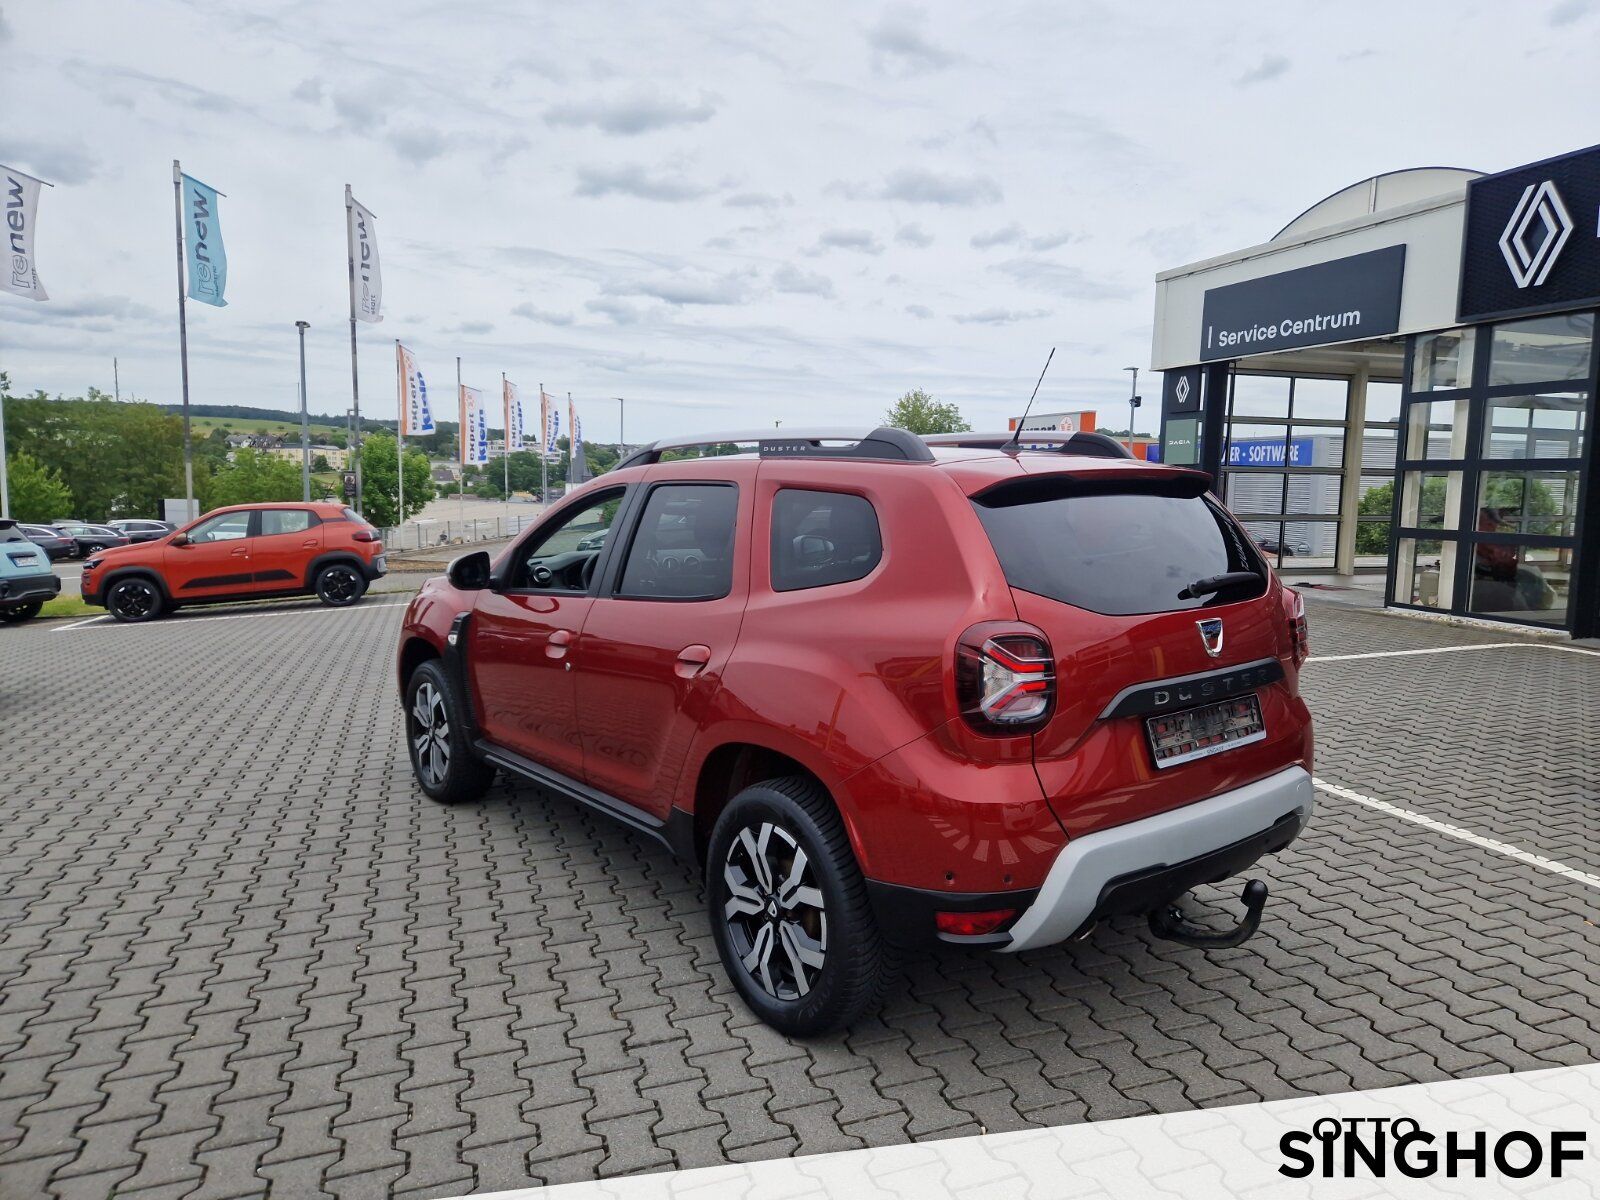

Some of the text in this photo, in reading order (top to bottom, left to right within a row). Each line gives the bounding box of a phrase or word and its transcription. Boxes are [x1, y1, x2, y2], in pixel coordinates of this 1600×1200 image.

[6, 175, 31, 289] renew
[193, 188, 215, 296] renew
[1218, 310, 1361, 347] Service Centrum
